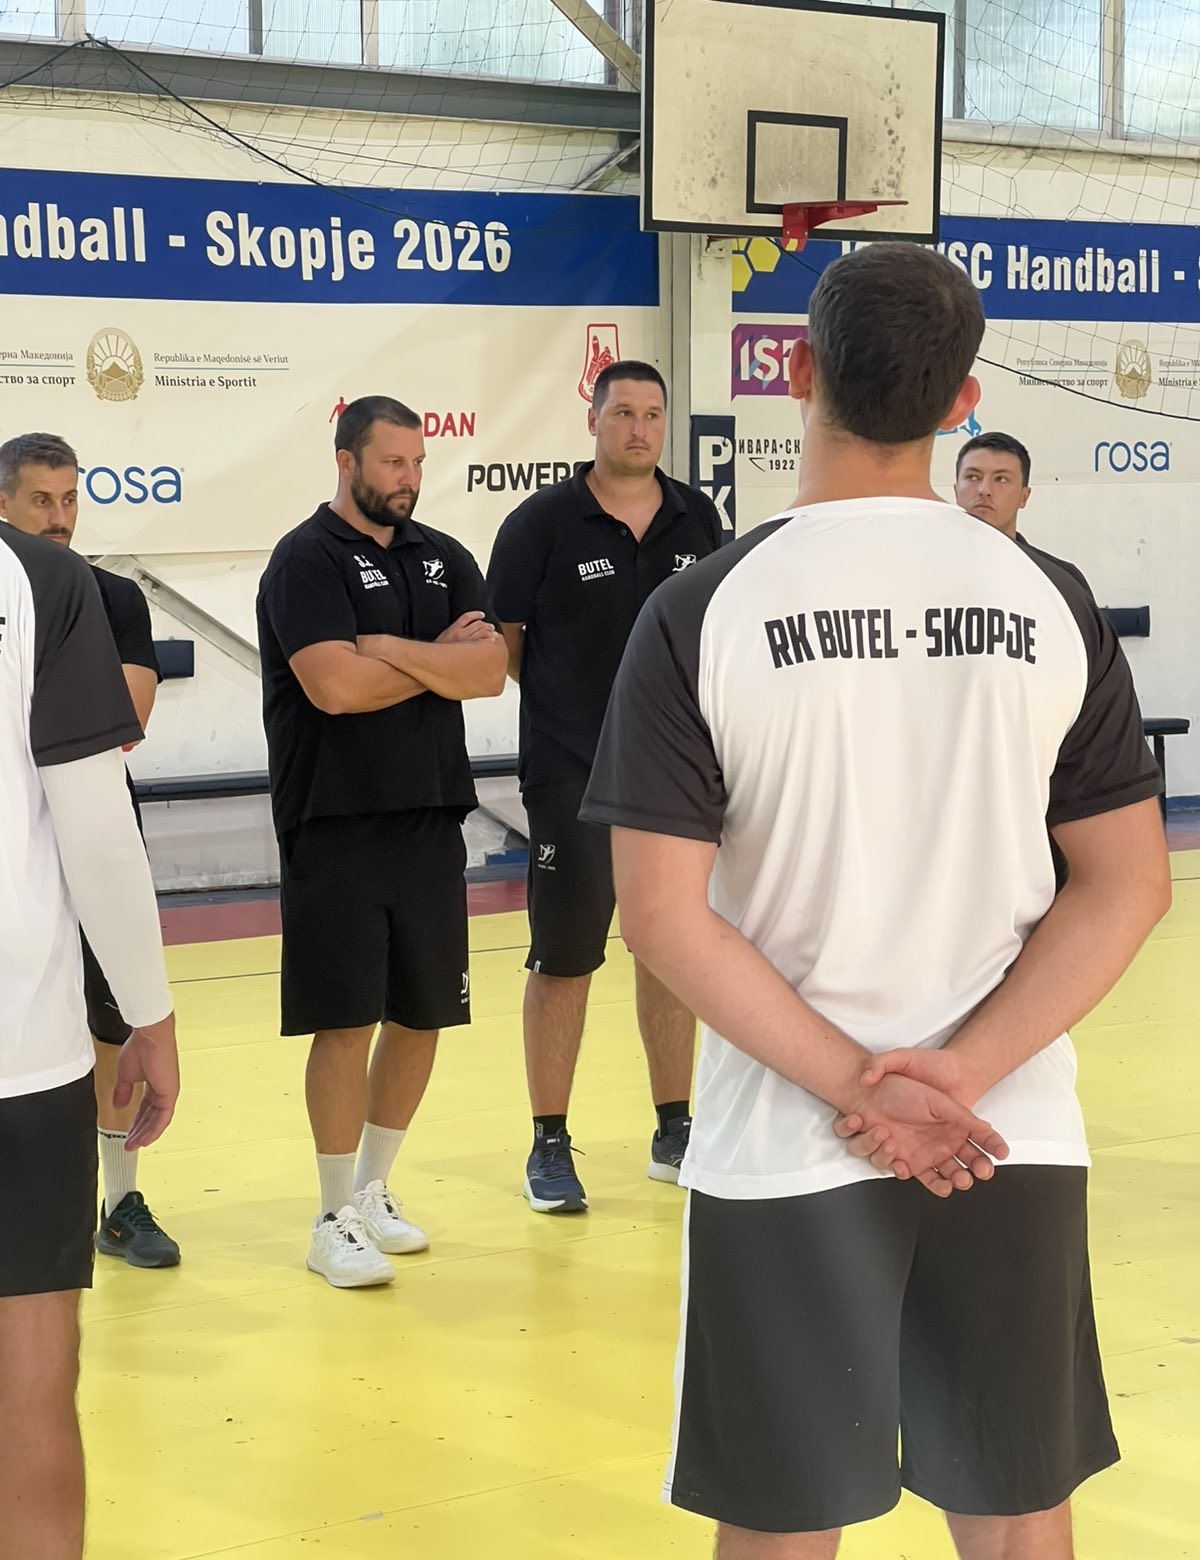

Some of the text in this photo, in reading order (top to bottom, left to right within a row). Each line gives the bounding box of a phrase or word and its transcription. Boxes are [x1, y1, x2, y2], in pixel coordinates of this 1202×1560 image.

[0, 202, 146, 262] dball
[205, 210, 375, 281] Skopje
[394, 218, 512, 272] 2026
[937, 241, 993, 290] SC
[1007, 245, 1159, 293] Handball
[20, 350, 74, 361] Македонија
[154, 353, 195, 364] Republika
[203, 353, 252, 365] Maqedonisë
[252, 355, 262, 363] së
[263, 354, 289, 363] Veriut
[26, 376, 40, 385] за
[42, 376, 76, 388] спорт
[155, 375, 257, 389] Ministria e Sportit
[1094, 441, 1170, 472] rosa
[768, 459, 795, 471] 1922
[78, 466, 182, 505] osa
[577, 558, 614, 576] BUTEL
[360, 569, 387, 584] BUTEL
[764, 613, 816, 669] RK
[813, 608, 899, 659] BUTEL
[925, 607, 1037, 665] SKOPJE
